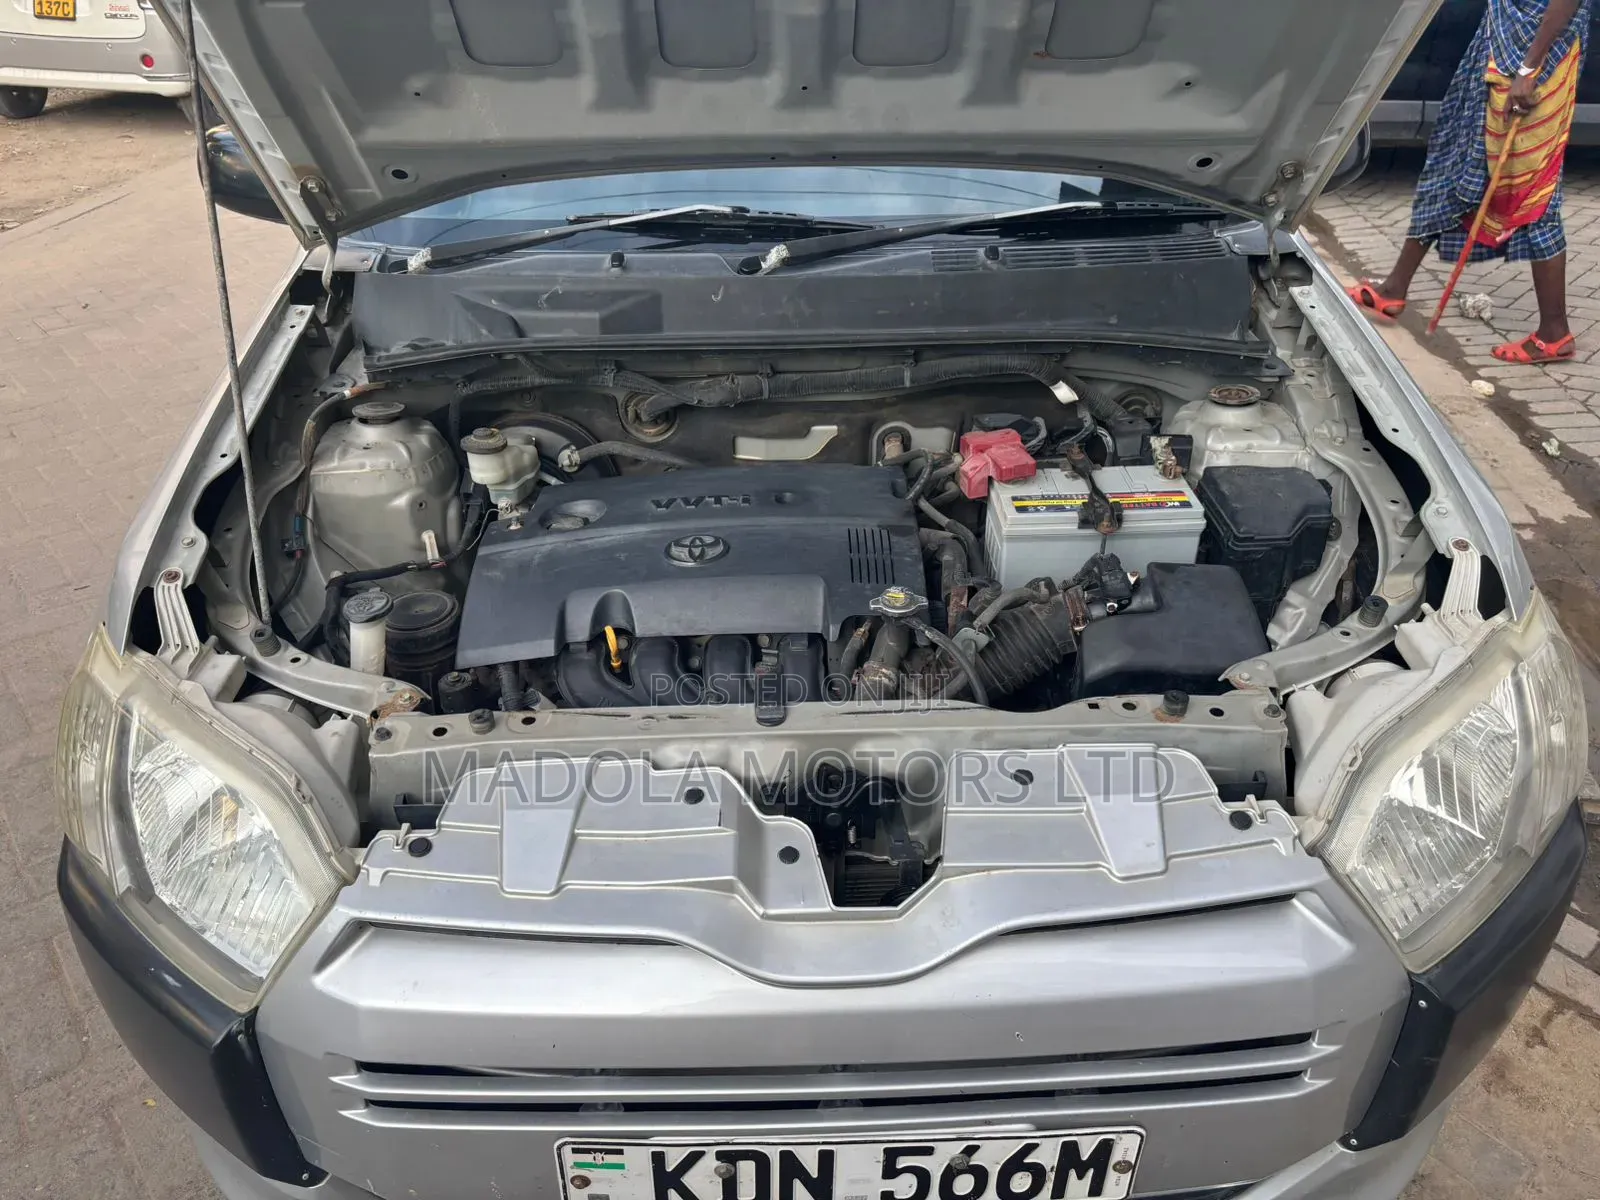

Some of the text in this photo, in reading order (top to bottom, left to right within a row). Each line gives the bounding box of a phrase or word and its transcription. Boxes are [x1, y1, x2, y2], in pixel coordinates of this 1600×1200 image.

[36, 1, 71, 17] 137C
[651, 1138, 1115, 1200] KDN 566M
